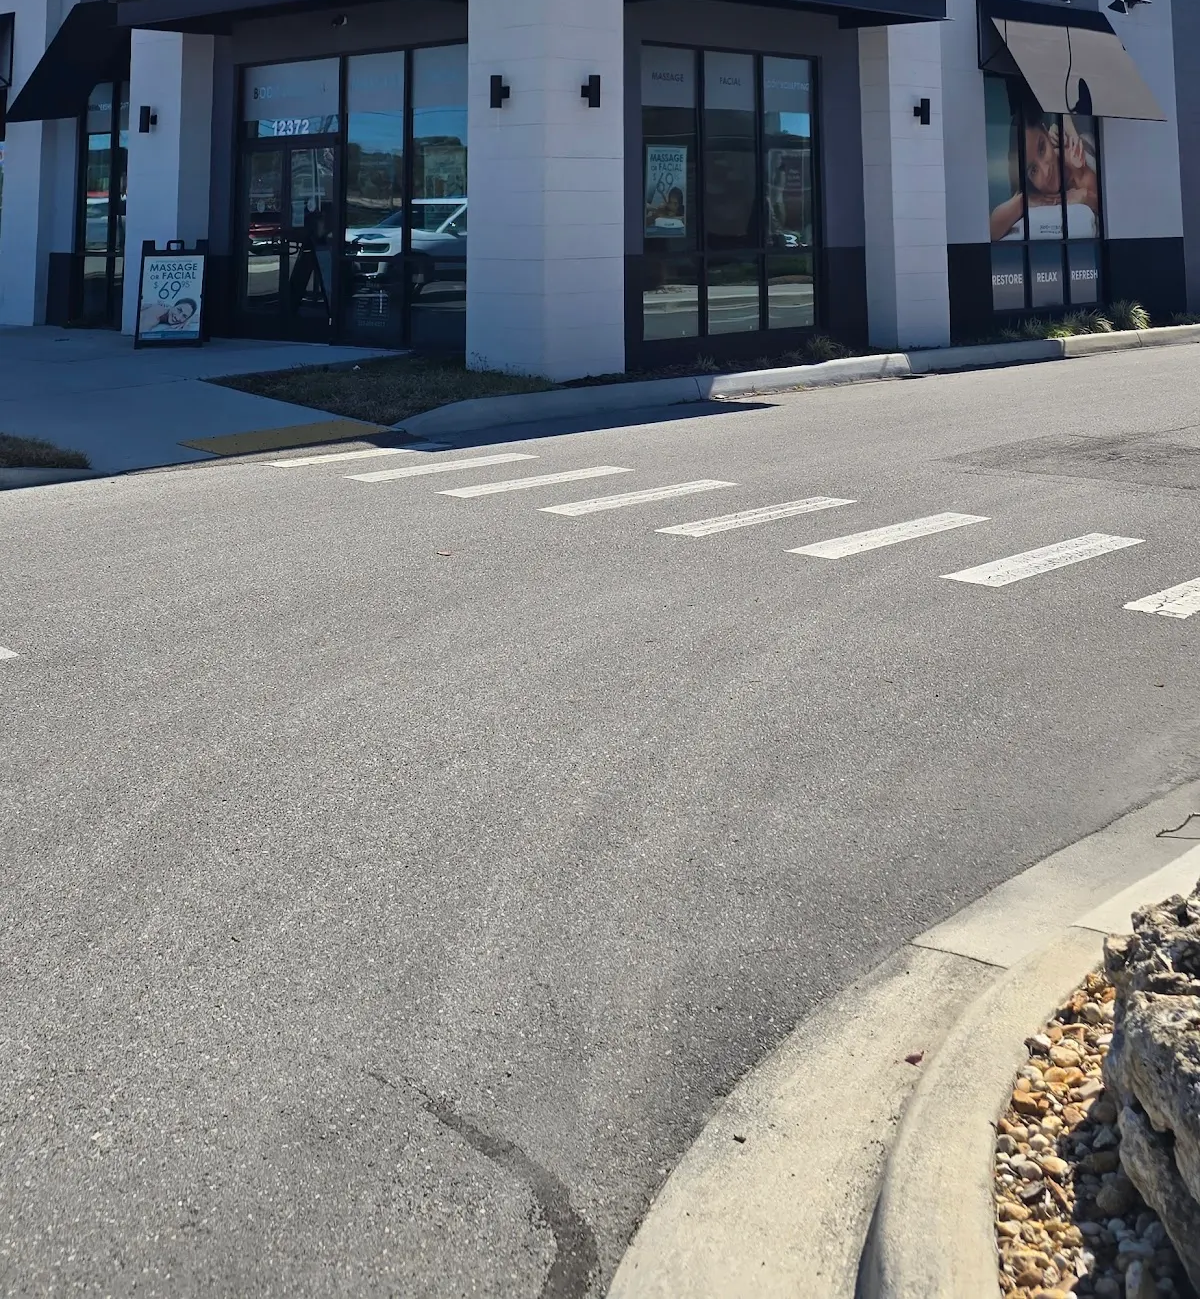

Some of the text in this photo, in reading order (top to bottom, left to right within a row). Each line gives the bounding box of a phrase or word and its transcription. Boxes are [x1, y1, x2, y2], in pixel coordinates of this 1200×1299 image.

[652, 71, 684, 83] MASSAGE
[719, 76, 741, 86] FACIAL
[271, 118, 310, 136] 12372
[650, 153, 684, 163] MASSAGE
[658, 163, 683, 172] FACIAL
[150, 263, 198, 272] MASSAGE
[162, 271, 196, 280] FACIAL
[992, 269, 1098, 285] RESTORE RELAX REFRESH
